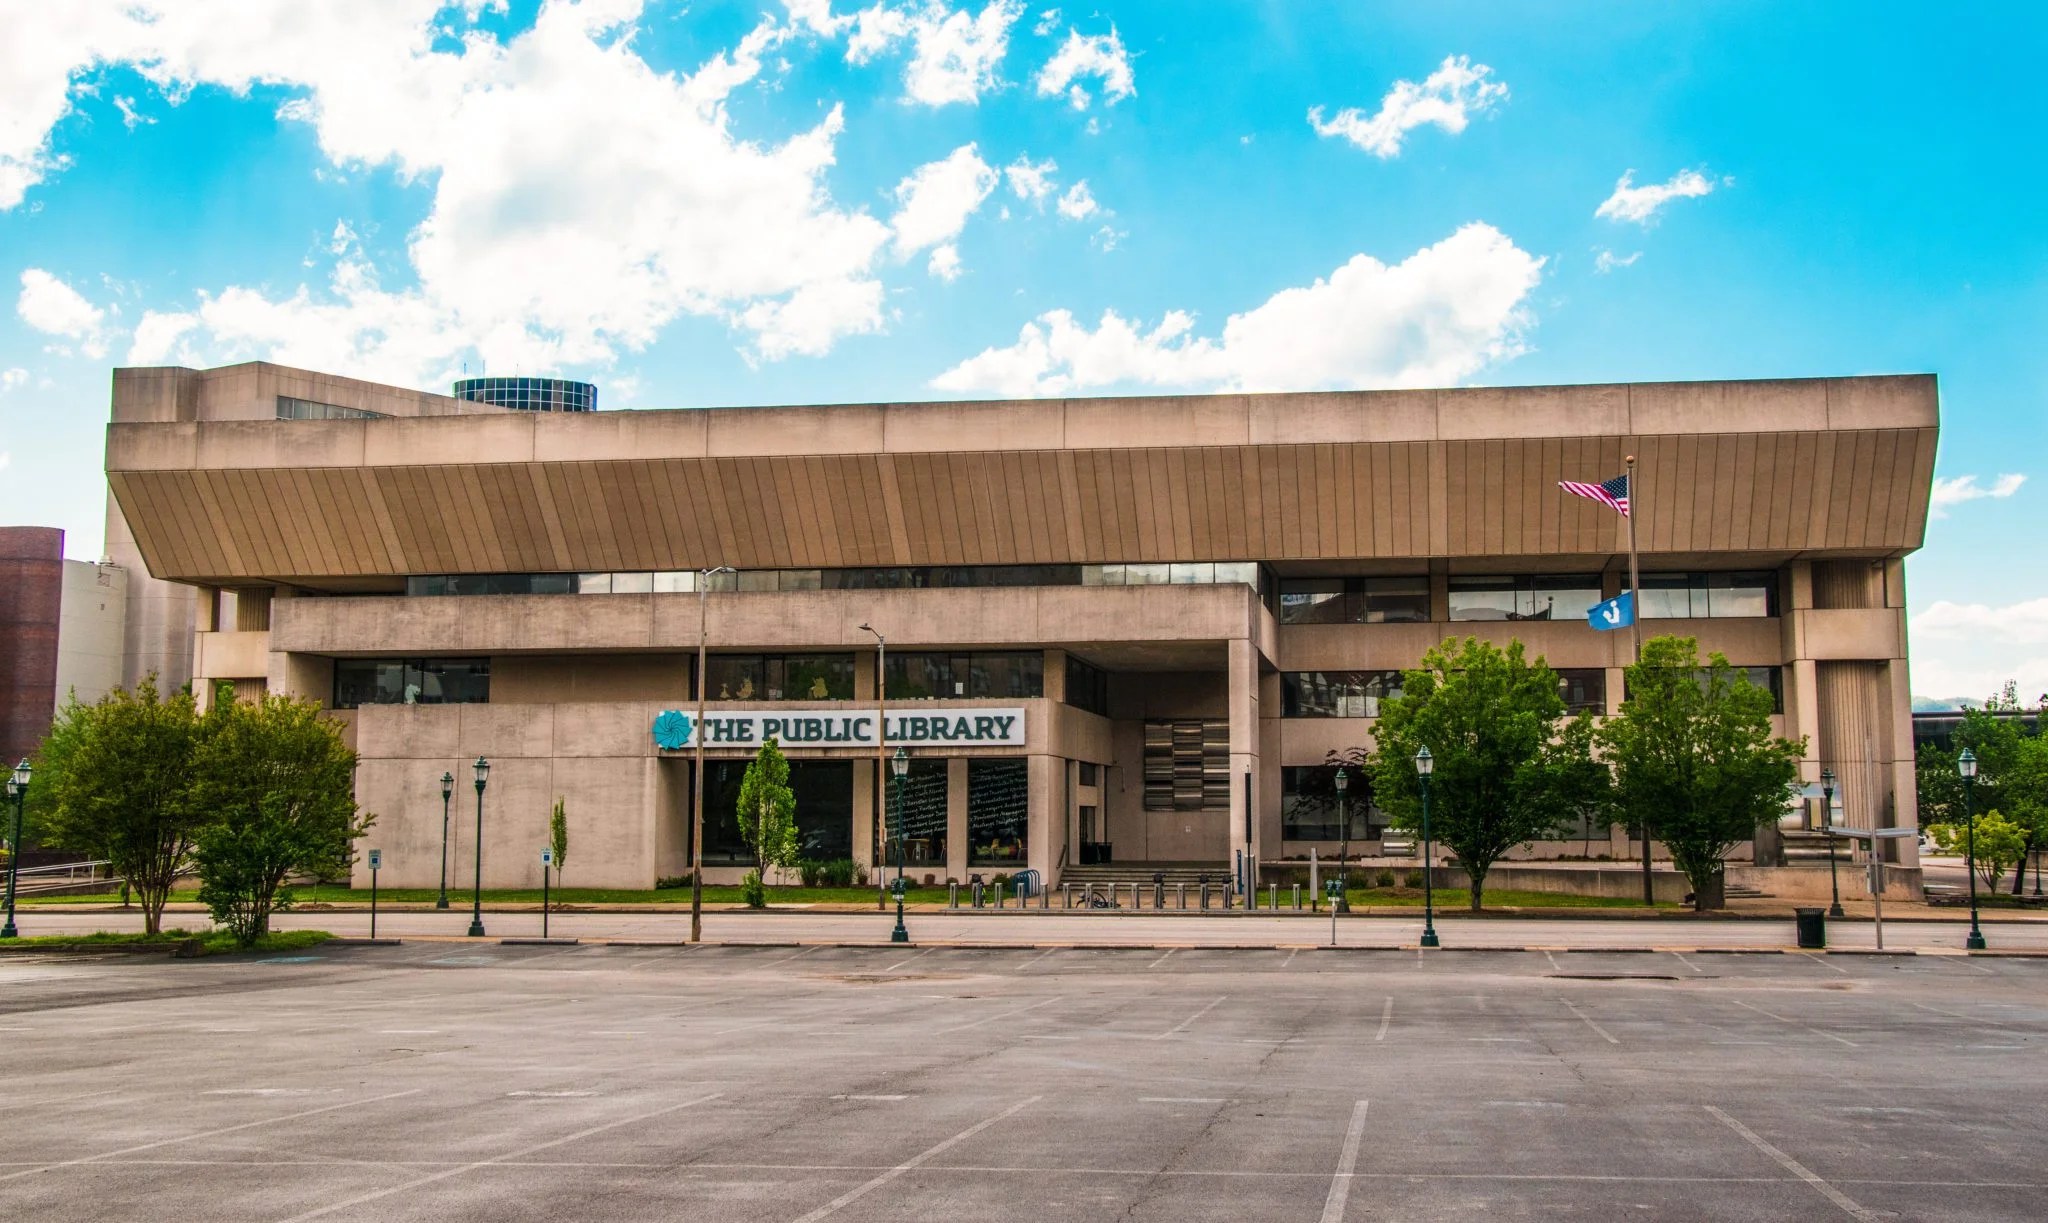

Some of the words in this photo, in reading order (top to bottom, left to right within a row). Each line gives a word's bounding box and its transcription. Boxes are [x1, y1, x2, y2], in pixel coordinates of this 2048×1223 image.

[693, 718, 754, 742] THE
[762, 717, 871, 742] PUBLIC
[883, 716, 1015, 741] LIBRARY
